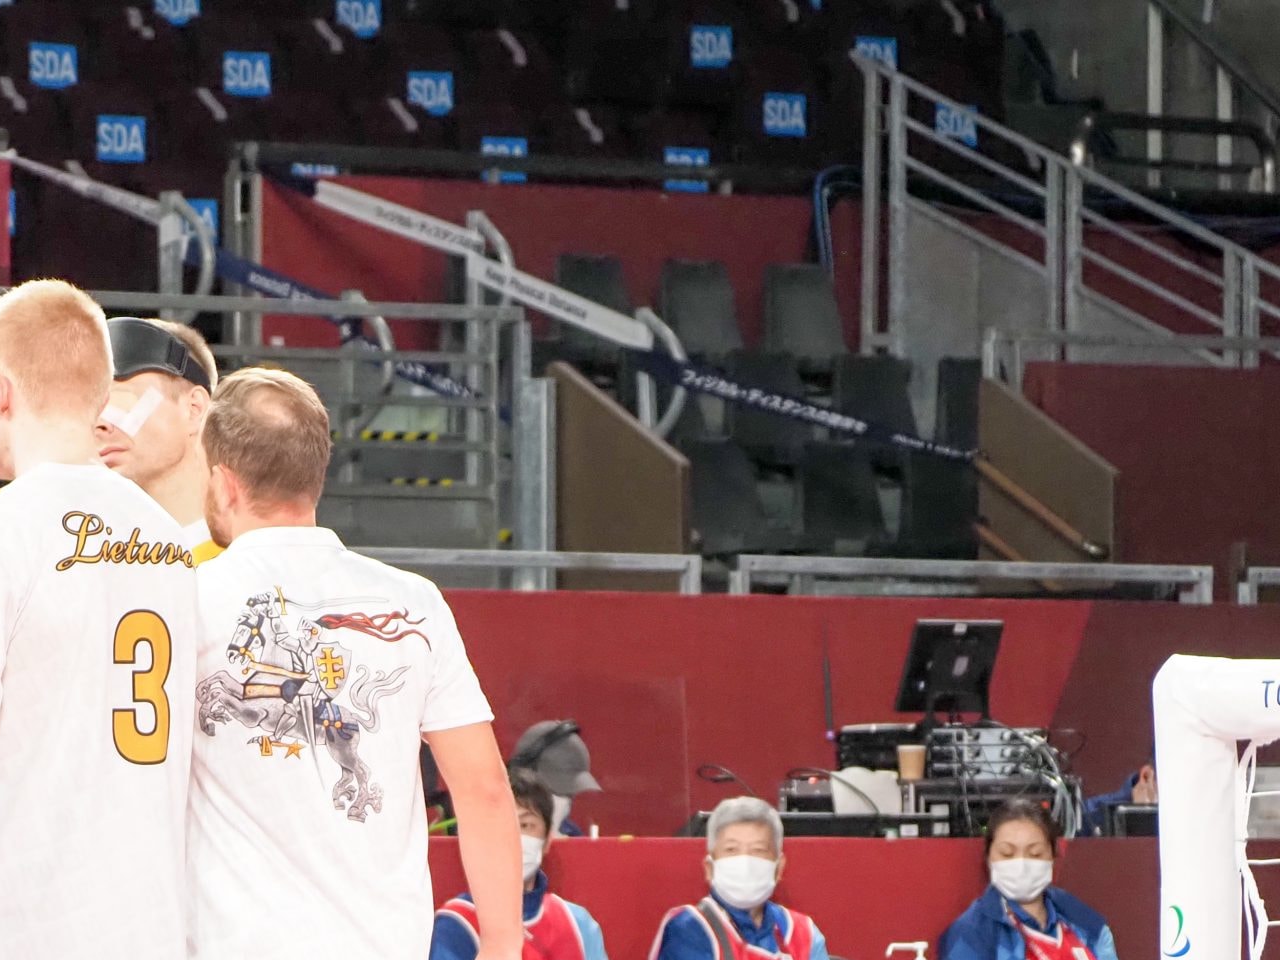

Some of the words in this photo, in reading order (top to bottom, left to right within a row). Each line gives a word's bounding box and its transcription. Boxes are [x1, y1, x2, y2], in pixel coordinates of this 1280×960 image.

[337, 0, 381, 29] SDA
[691, 31, 732, 60] SDA
[28, 49, 77, 80] SDA
[224, 58, 270, 89] SDA
[407, 78, 453, 107] SDA
[763, 101, 806, 130] SDA
[96, 122, 145, 154] SDA
[112, 609, 172, 765] 3
